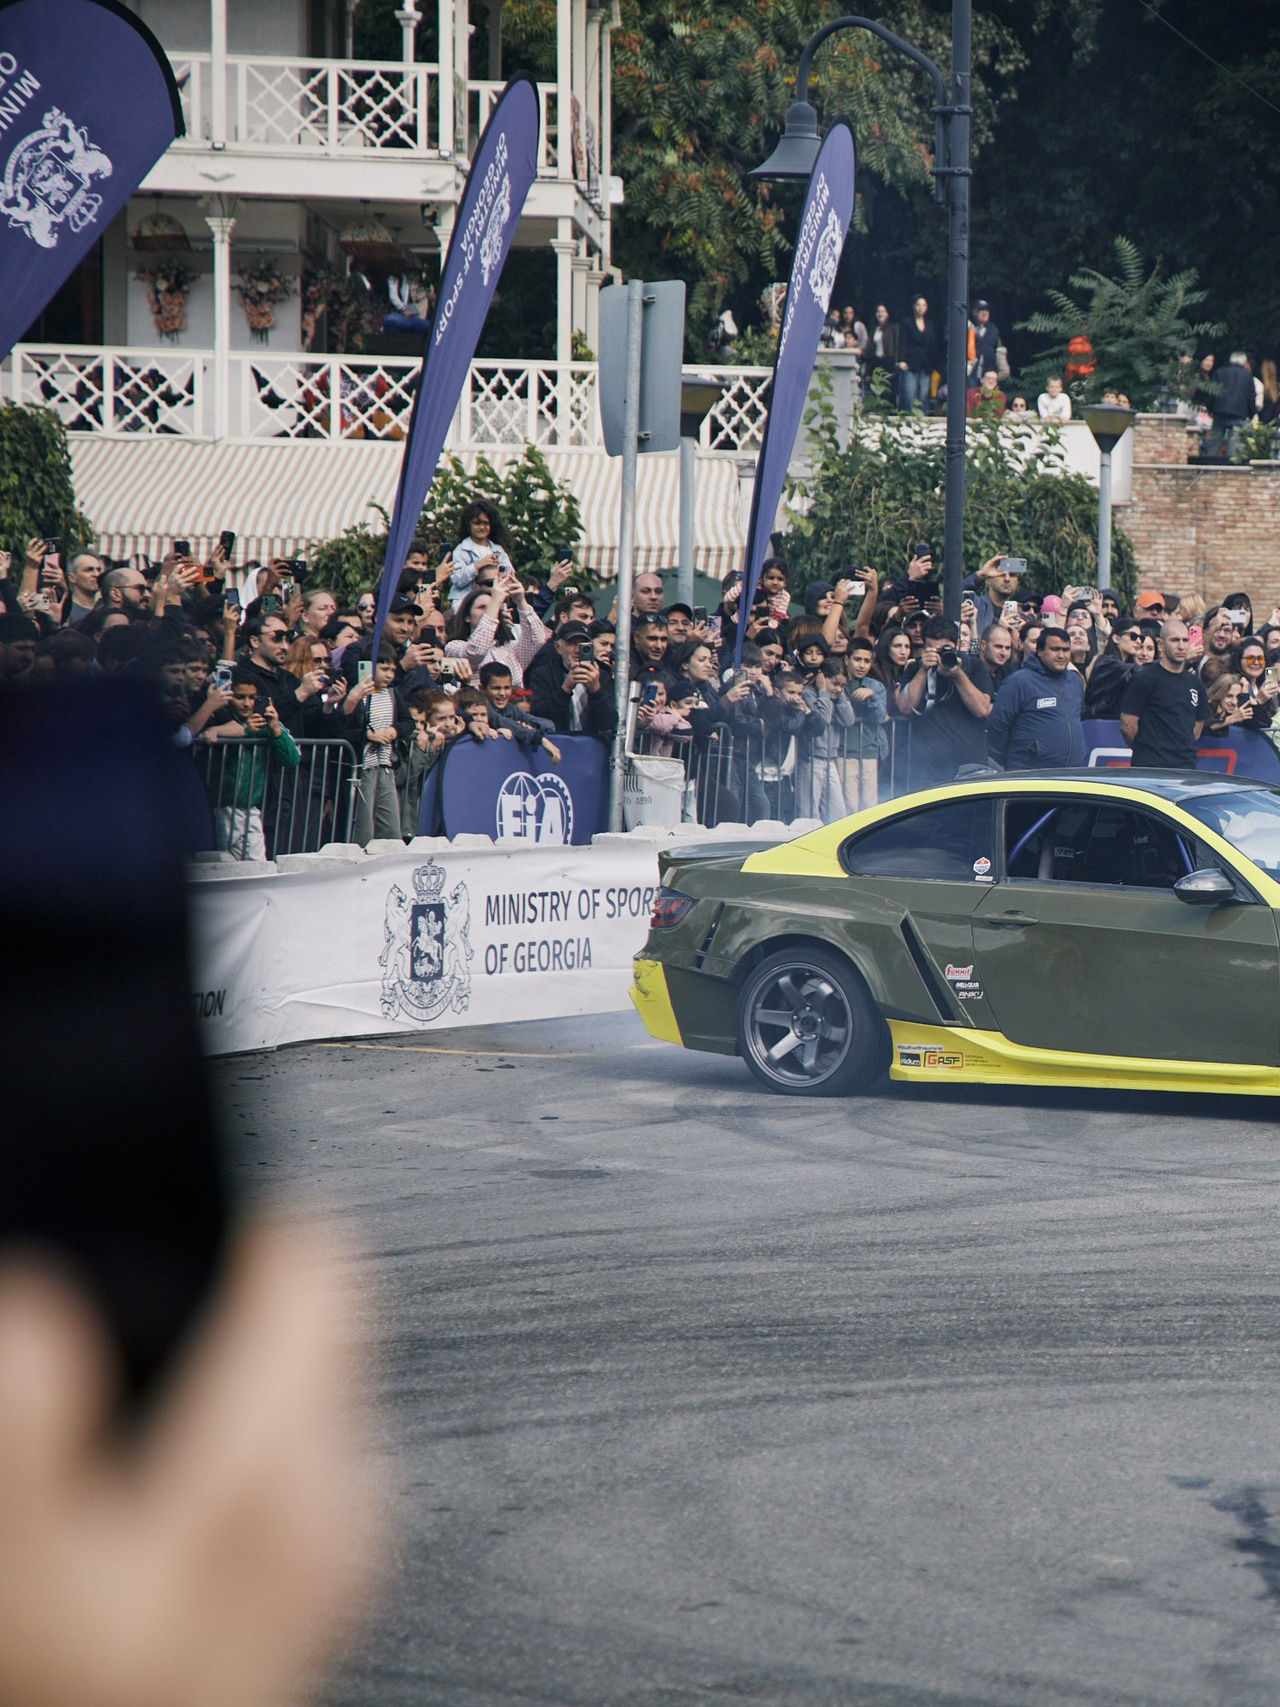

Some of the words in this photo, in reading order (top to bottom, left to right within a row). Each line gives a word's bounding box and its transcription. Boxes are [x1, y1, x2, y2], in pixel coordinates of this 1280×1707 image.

[495, 132, 505, 164] OF
[474, 145, 508, 244] MINISTRY
[815, 172, 825, 202] OF
[460, 163, 495, 252] GEORGIA
[800, 183, 829, 275] MINISTRY
[463, 242, 475, 276] OF
[794, 274, 802, 304] OF
[435, 272, 463, 346] SPORT
[485, 890, 572, 926] MINISTRY
[577, 888, 601, 920] OF
[606, 885, 661, 919] SPOR
[485, 943, 509, 976] OF
[513, 937, 593, 974] GEORGIA
[927, 1054, 960, 1065] GASF
